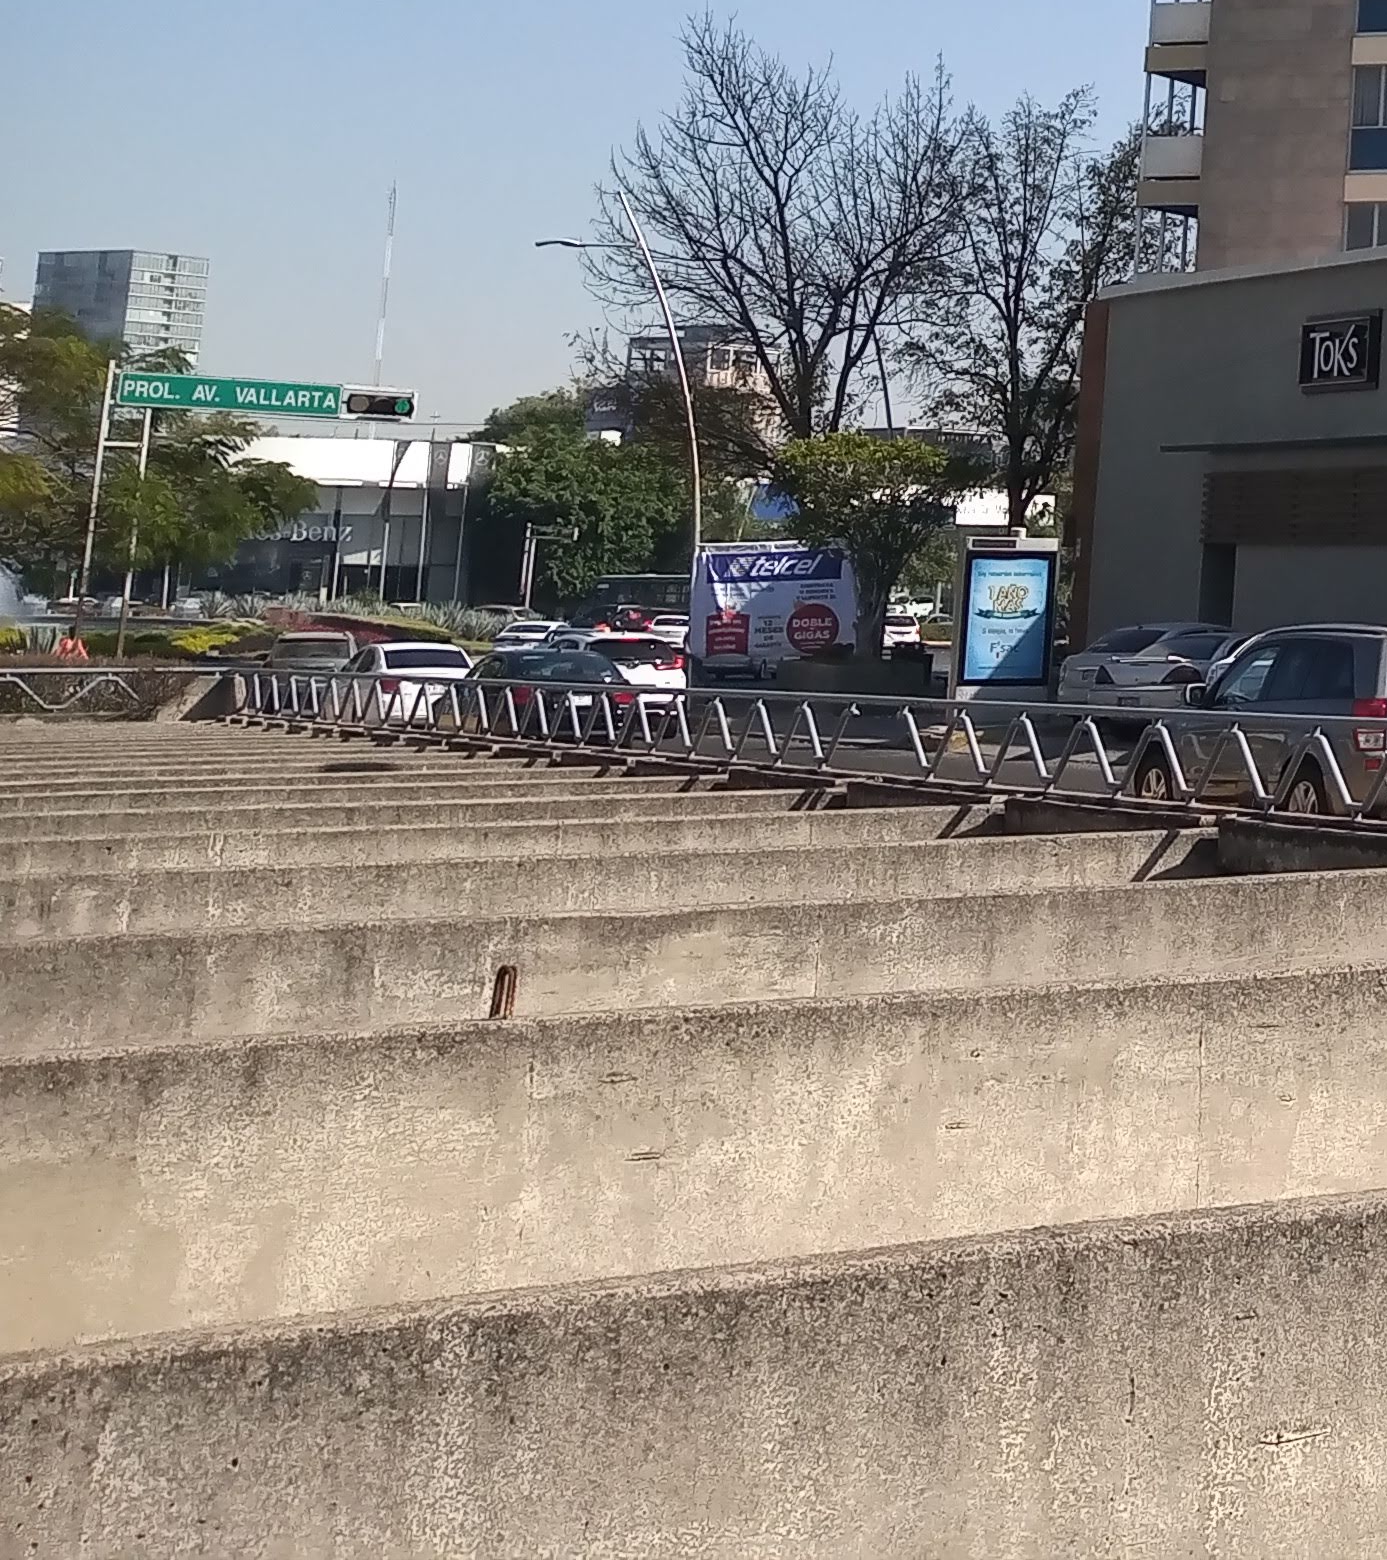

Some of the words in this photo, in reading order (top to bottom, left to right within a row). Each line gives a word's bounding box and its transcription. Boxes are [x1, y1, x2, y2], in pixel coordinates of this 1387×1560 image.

[123, 380, 180, 400] PROL.
[192, 385, 221, 403] AV.
[236, 387, 337, 409] VALLARTA
[750, 554, 824, 577] telcel
[792, 618, 833, 628] DOBLE
[794, 630, 831, 640] GIGAS
